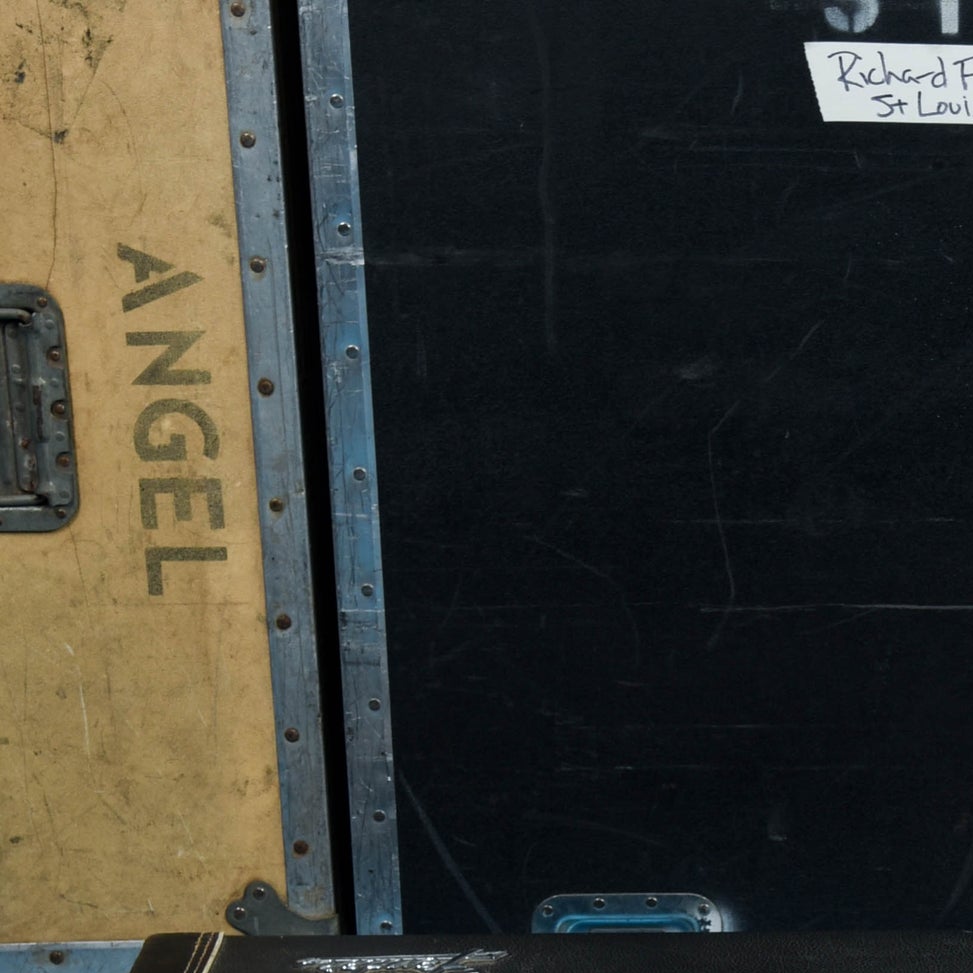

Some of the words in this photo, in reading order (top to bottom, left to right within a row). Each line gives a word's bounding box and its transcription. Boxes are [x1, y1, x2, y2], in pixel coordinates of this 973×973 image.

[827, 50, 948, 92] Richard
[871, 94, 907, 118] St
[116, 242, 228, 596] ANGEL
